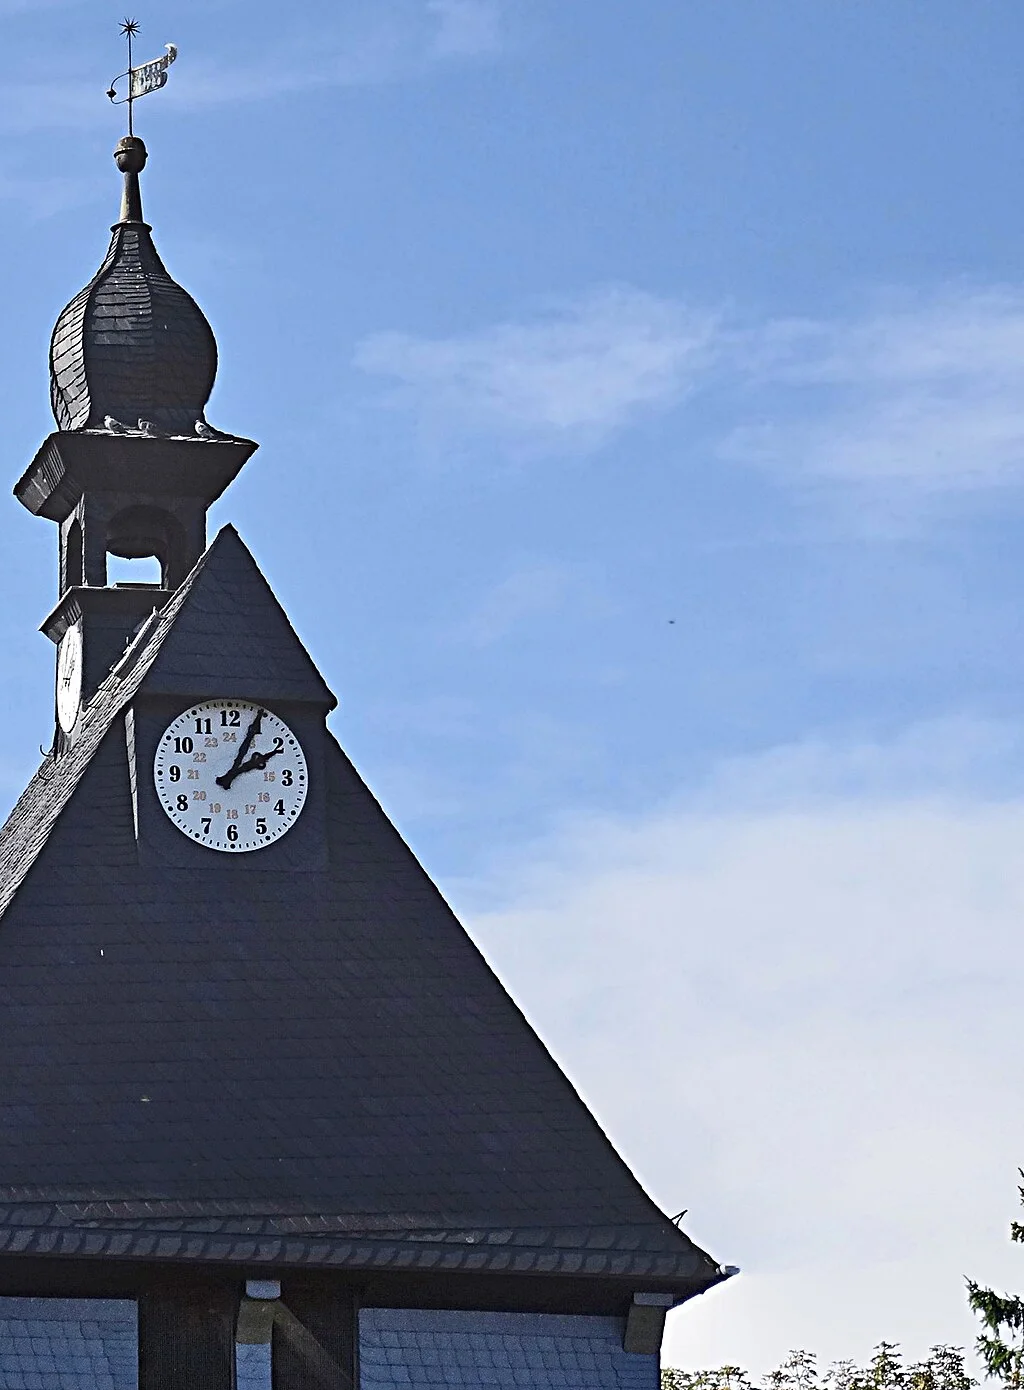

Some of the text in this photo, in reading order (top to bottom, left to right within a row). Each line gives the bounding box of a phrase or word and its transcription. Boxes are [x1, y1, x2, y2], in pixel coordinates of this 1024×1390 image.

[194, 718, 213, 735] 11
[220, 710, 240, 727] 12
[174, 737, 193, 754] 10
[222, 732, 237, 743] 24
[273, 737, 284, 754] 2
[169, 765, 181, 782] 9
[281, 769, 294, 786] 3
[176, 794, 189, 812] 8
[273, 799, 286, 815] 4
[201, 817, 212, 835] 7
[226, 824, 239, 842] 6
[255, 817, 268, 835] 5
